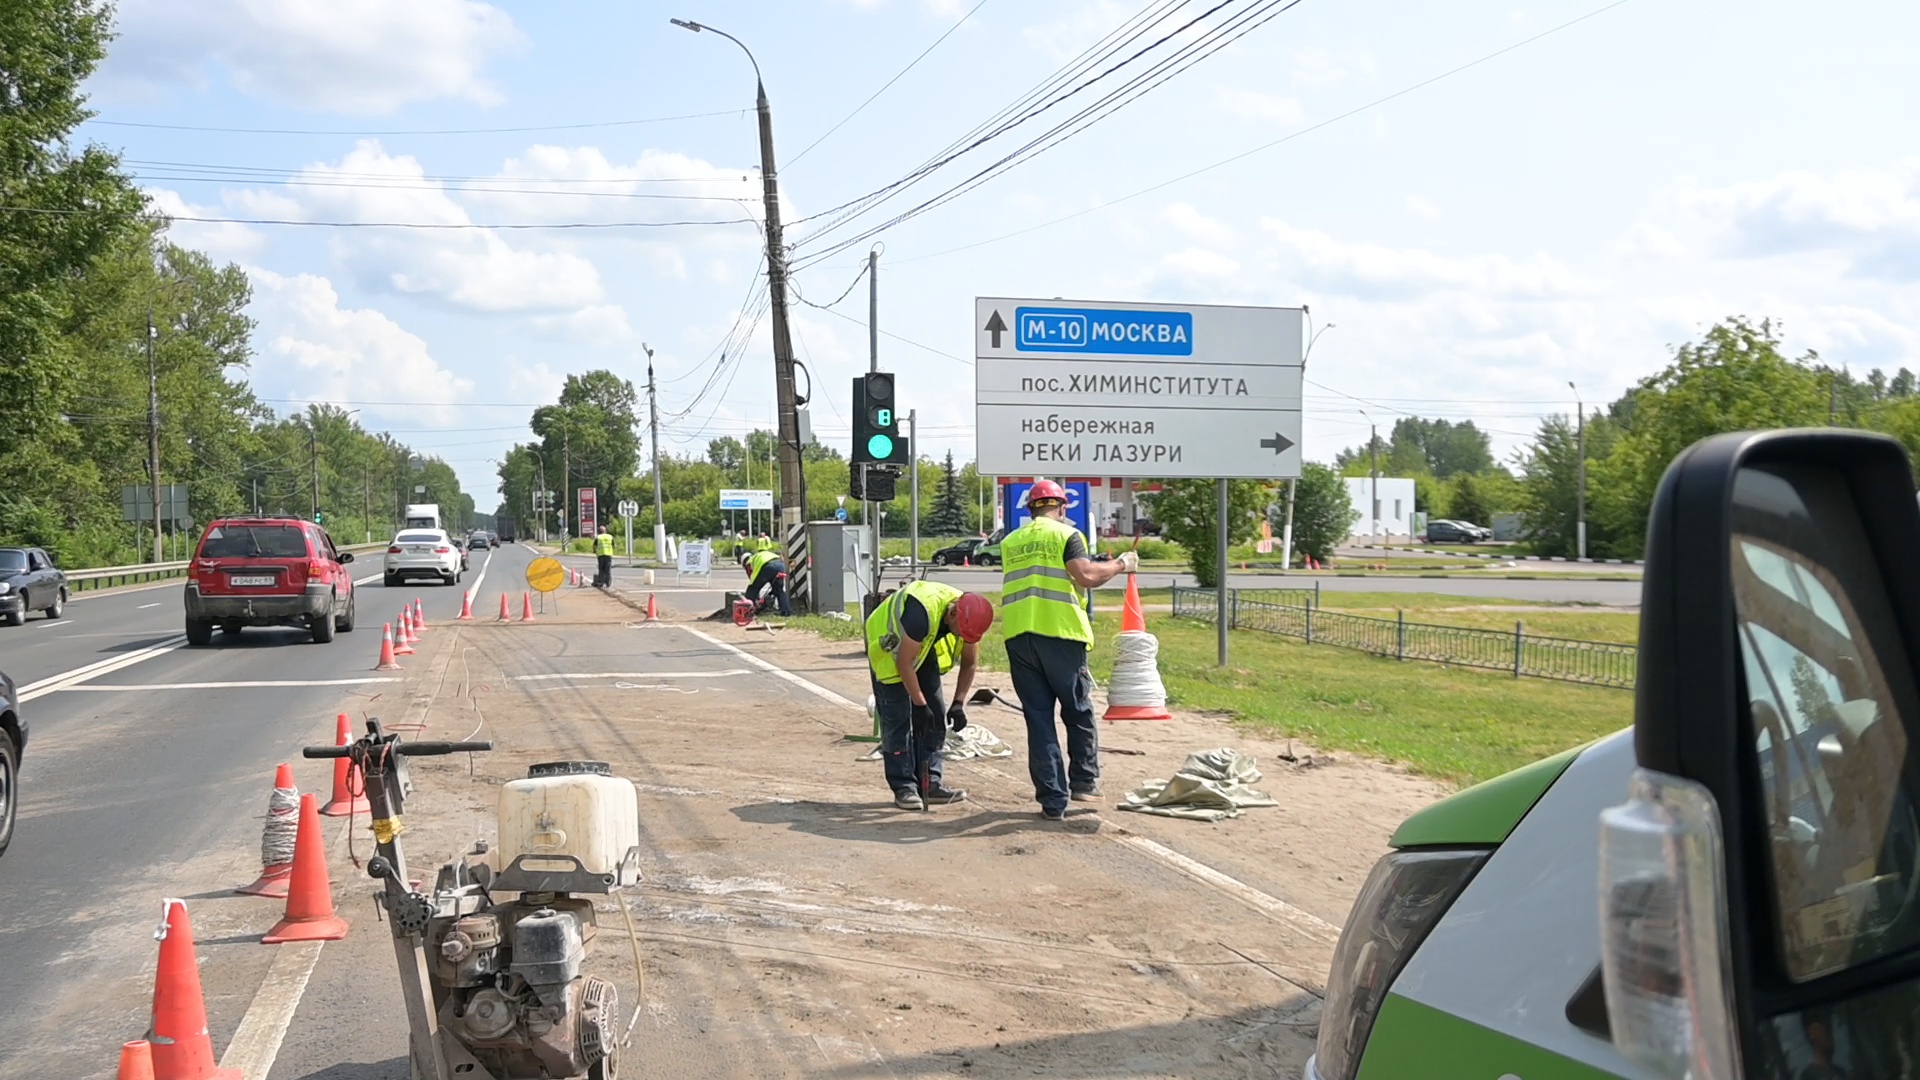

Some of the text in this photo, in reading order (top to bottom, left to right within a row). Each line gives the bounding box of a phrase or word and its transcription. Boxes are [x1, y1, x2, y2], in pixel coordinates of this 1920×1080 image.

[1028, 319, 1188, 344] М-10 МОСКВА
[1021, 413, 1155, 438] набережная
[1021, 443, 1183, 463] РЕКИ ЛАЗУРИ
